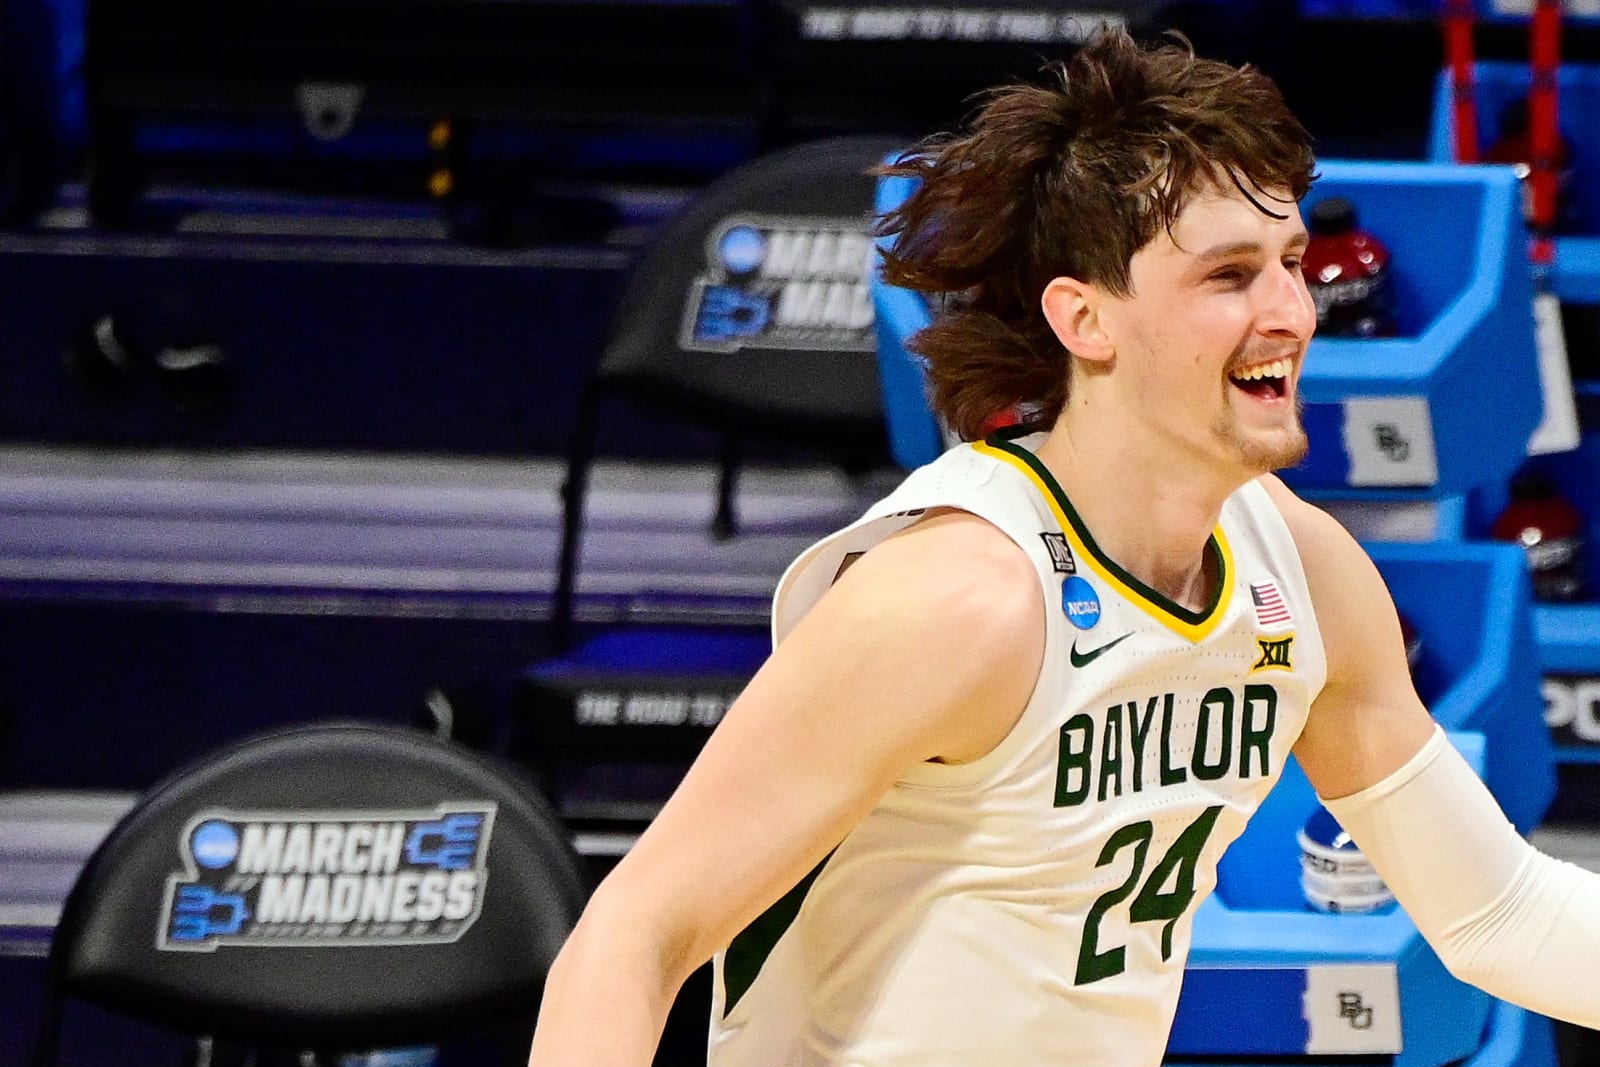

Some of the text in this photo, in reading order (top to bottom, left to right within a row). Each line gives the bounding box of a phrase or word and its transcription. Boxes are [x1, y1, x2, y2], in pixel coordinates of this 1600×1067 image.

[1067, 601, 1099, 616] NCAA
[1053, 684, 1278, 808] BAYLOR
[235, 821, 406, 875] MARCH
[255, 872, 478, 923] MADNESS
[1073, 804, 1226, 986] 24
